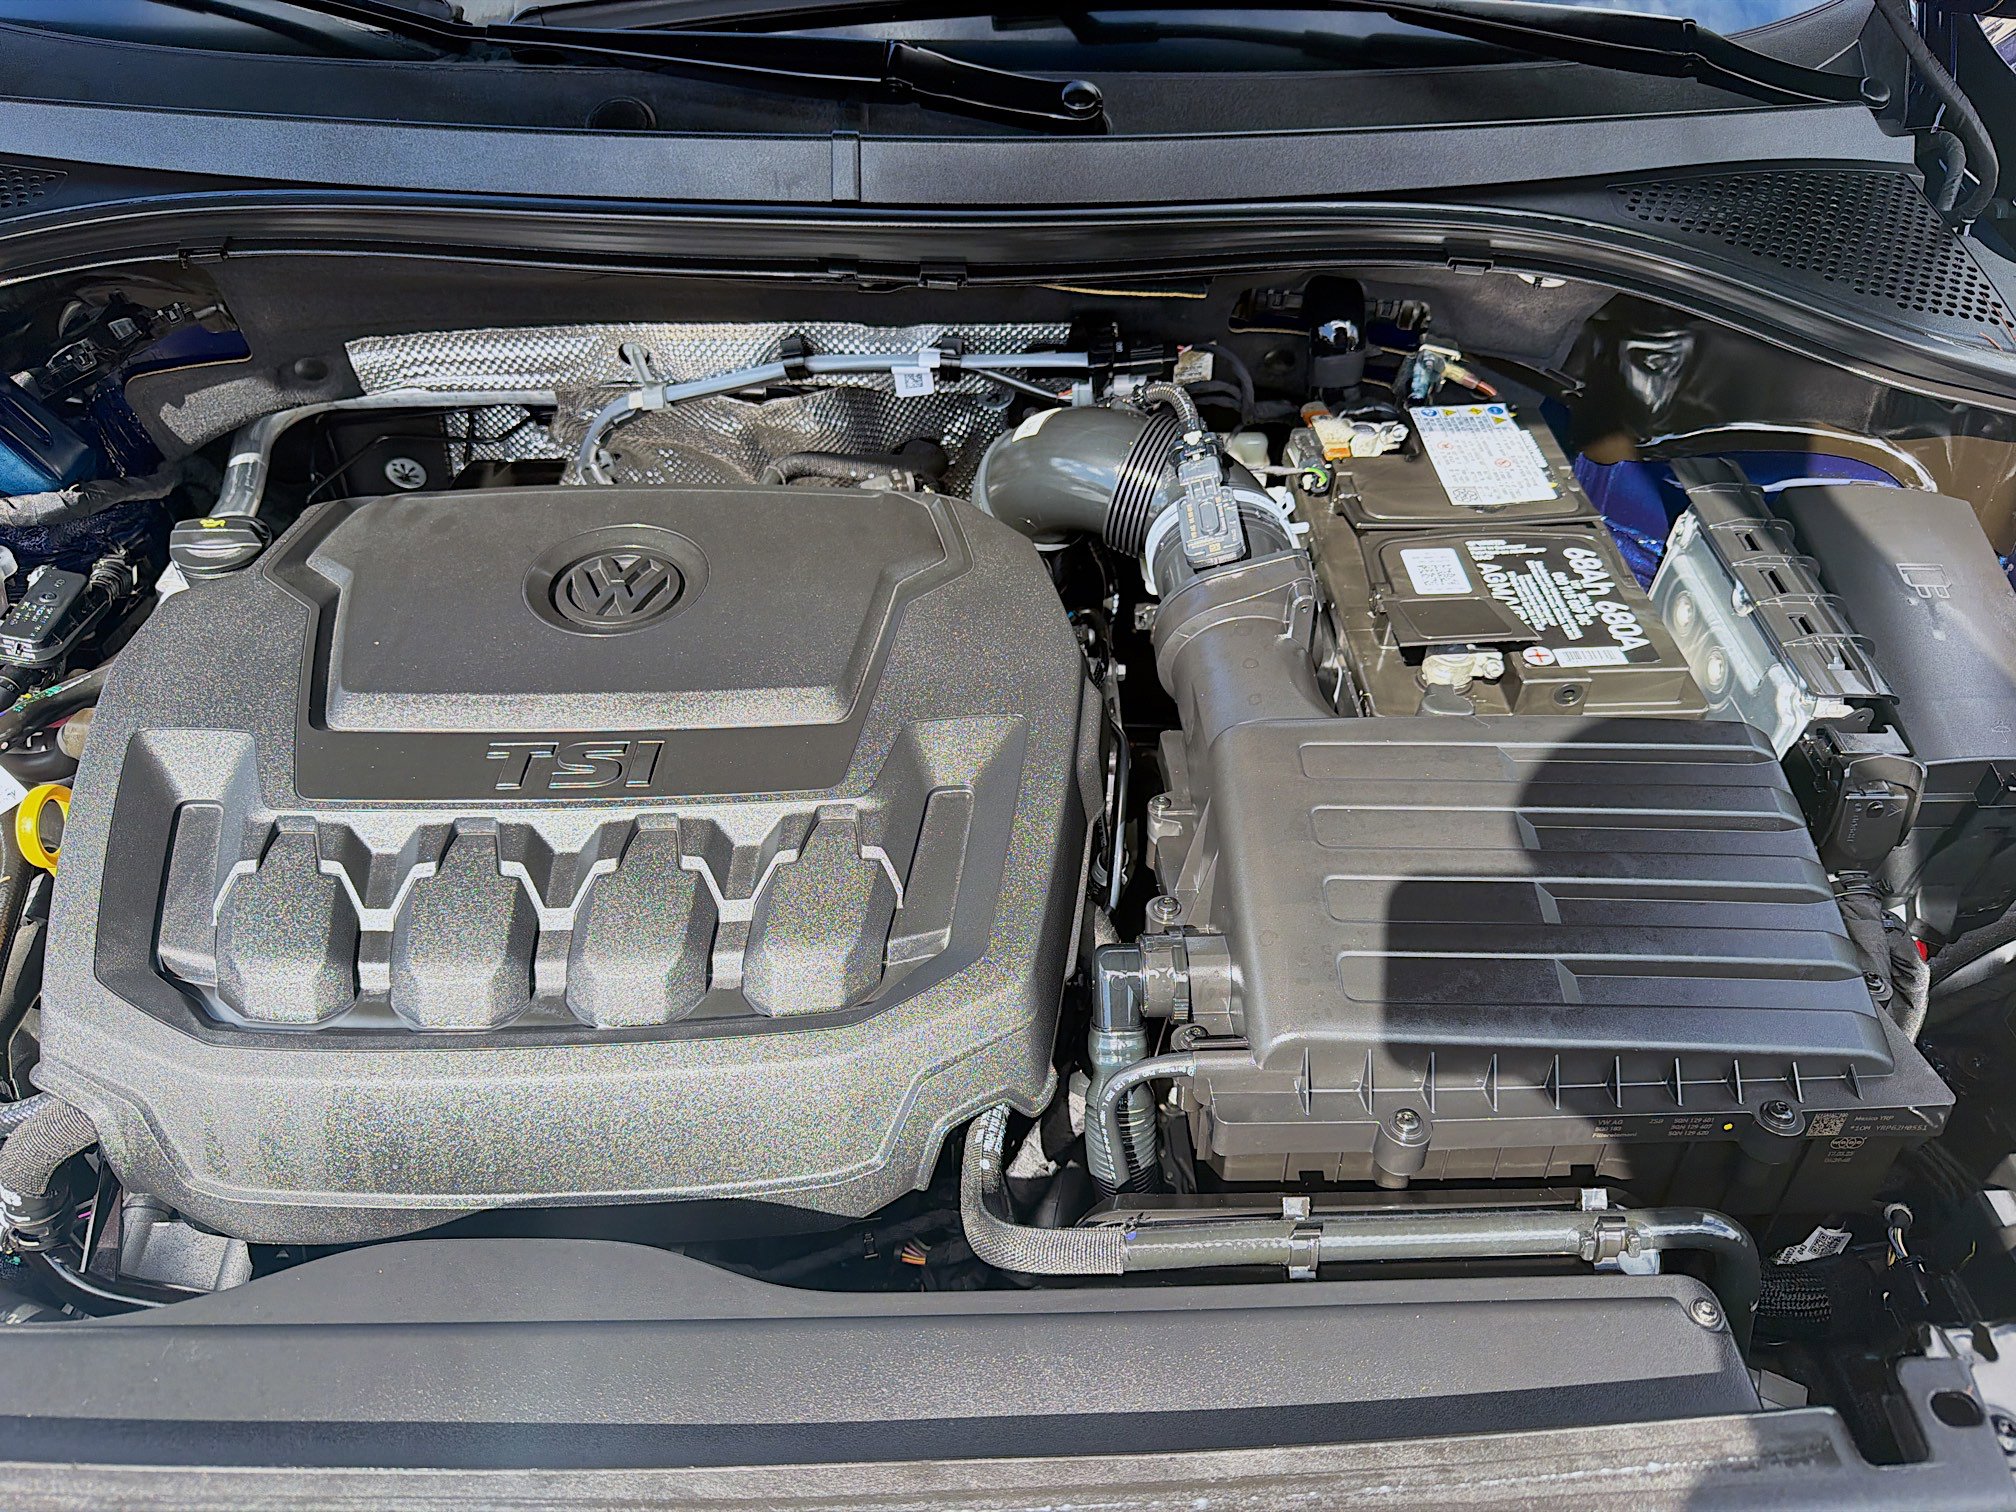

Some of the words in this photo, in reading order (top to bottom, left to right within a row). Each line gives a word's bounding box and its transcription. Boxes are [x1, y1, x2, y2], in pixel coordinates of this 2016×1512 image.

[1562, 547, 1616, 597] 68Ah
[1594, 600, 1651, 652] 680A
[486, 740, 666, 790] TSI
